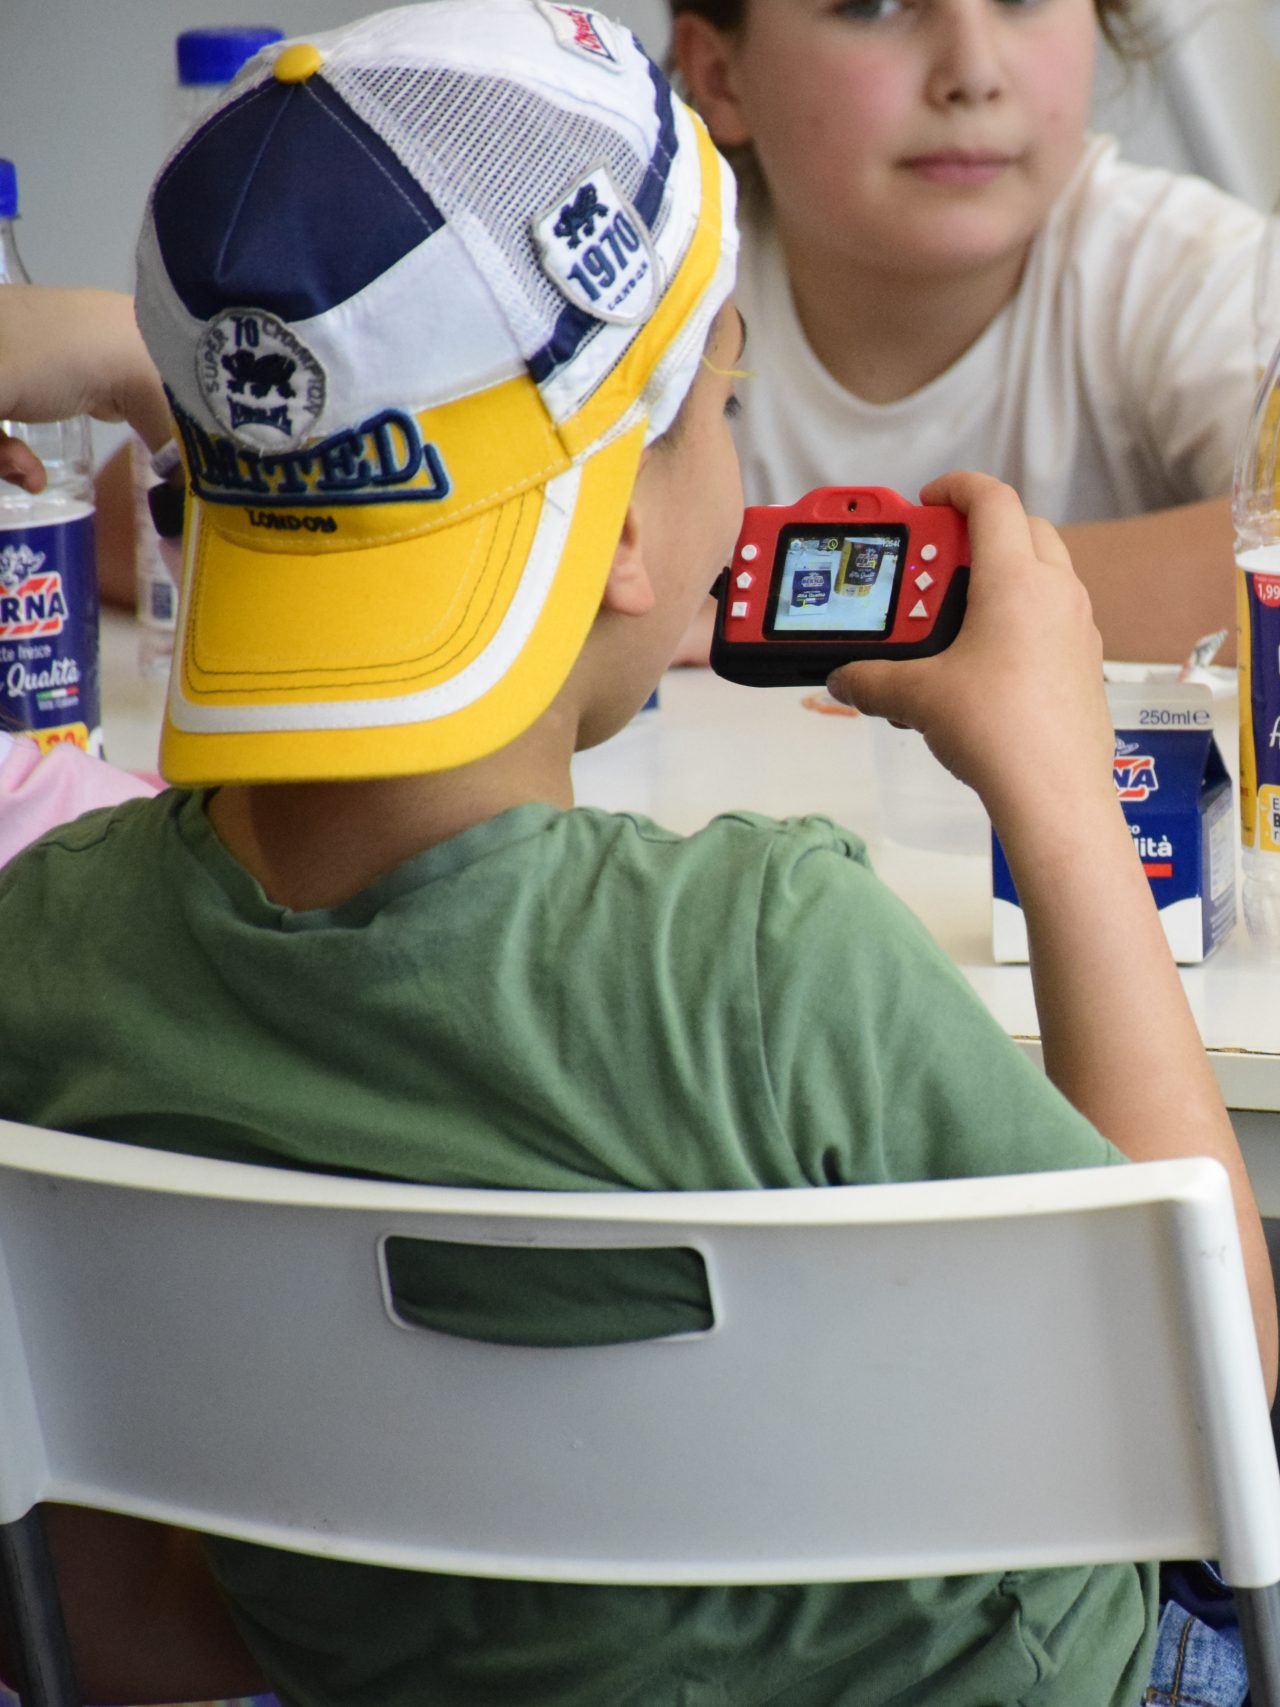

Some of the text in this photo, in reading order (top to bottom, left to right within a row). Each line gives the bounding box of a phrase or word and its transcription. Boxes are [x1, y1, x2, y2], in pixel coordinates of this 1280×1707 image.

[567, 209, 640, 302] 1970
[230, 316, 260, 348] 70
[204, 328, 228, 394] SUPER
[246, 507, 338, 532] LONDON
[1, 591, 66, 624] RNA
[7, 657, 80, 698] Qualità
[1138, 708, 1191, 727] 250ml
[1112, 767, 1159, 789] NA
[1134, 835, 1173, 858] lità
